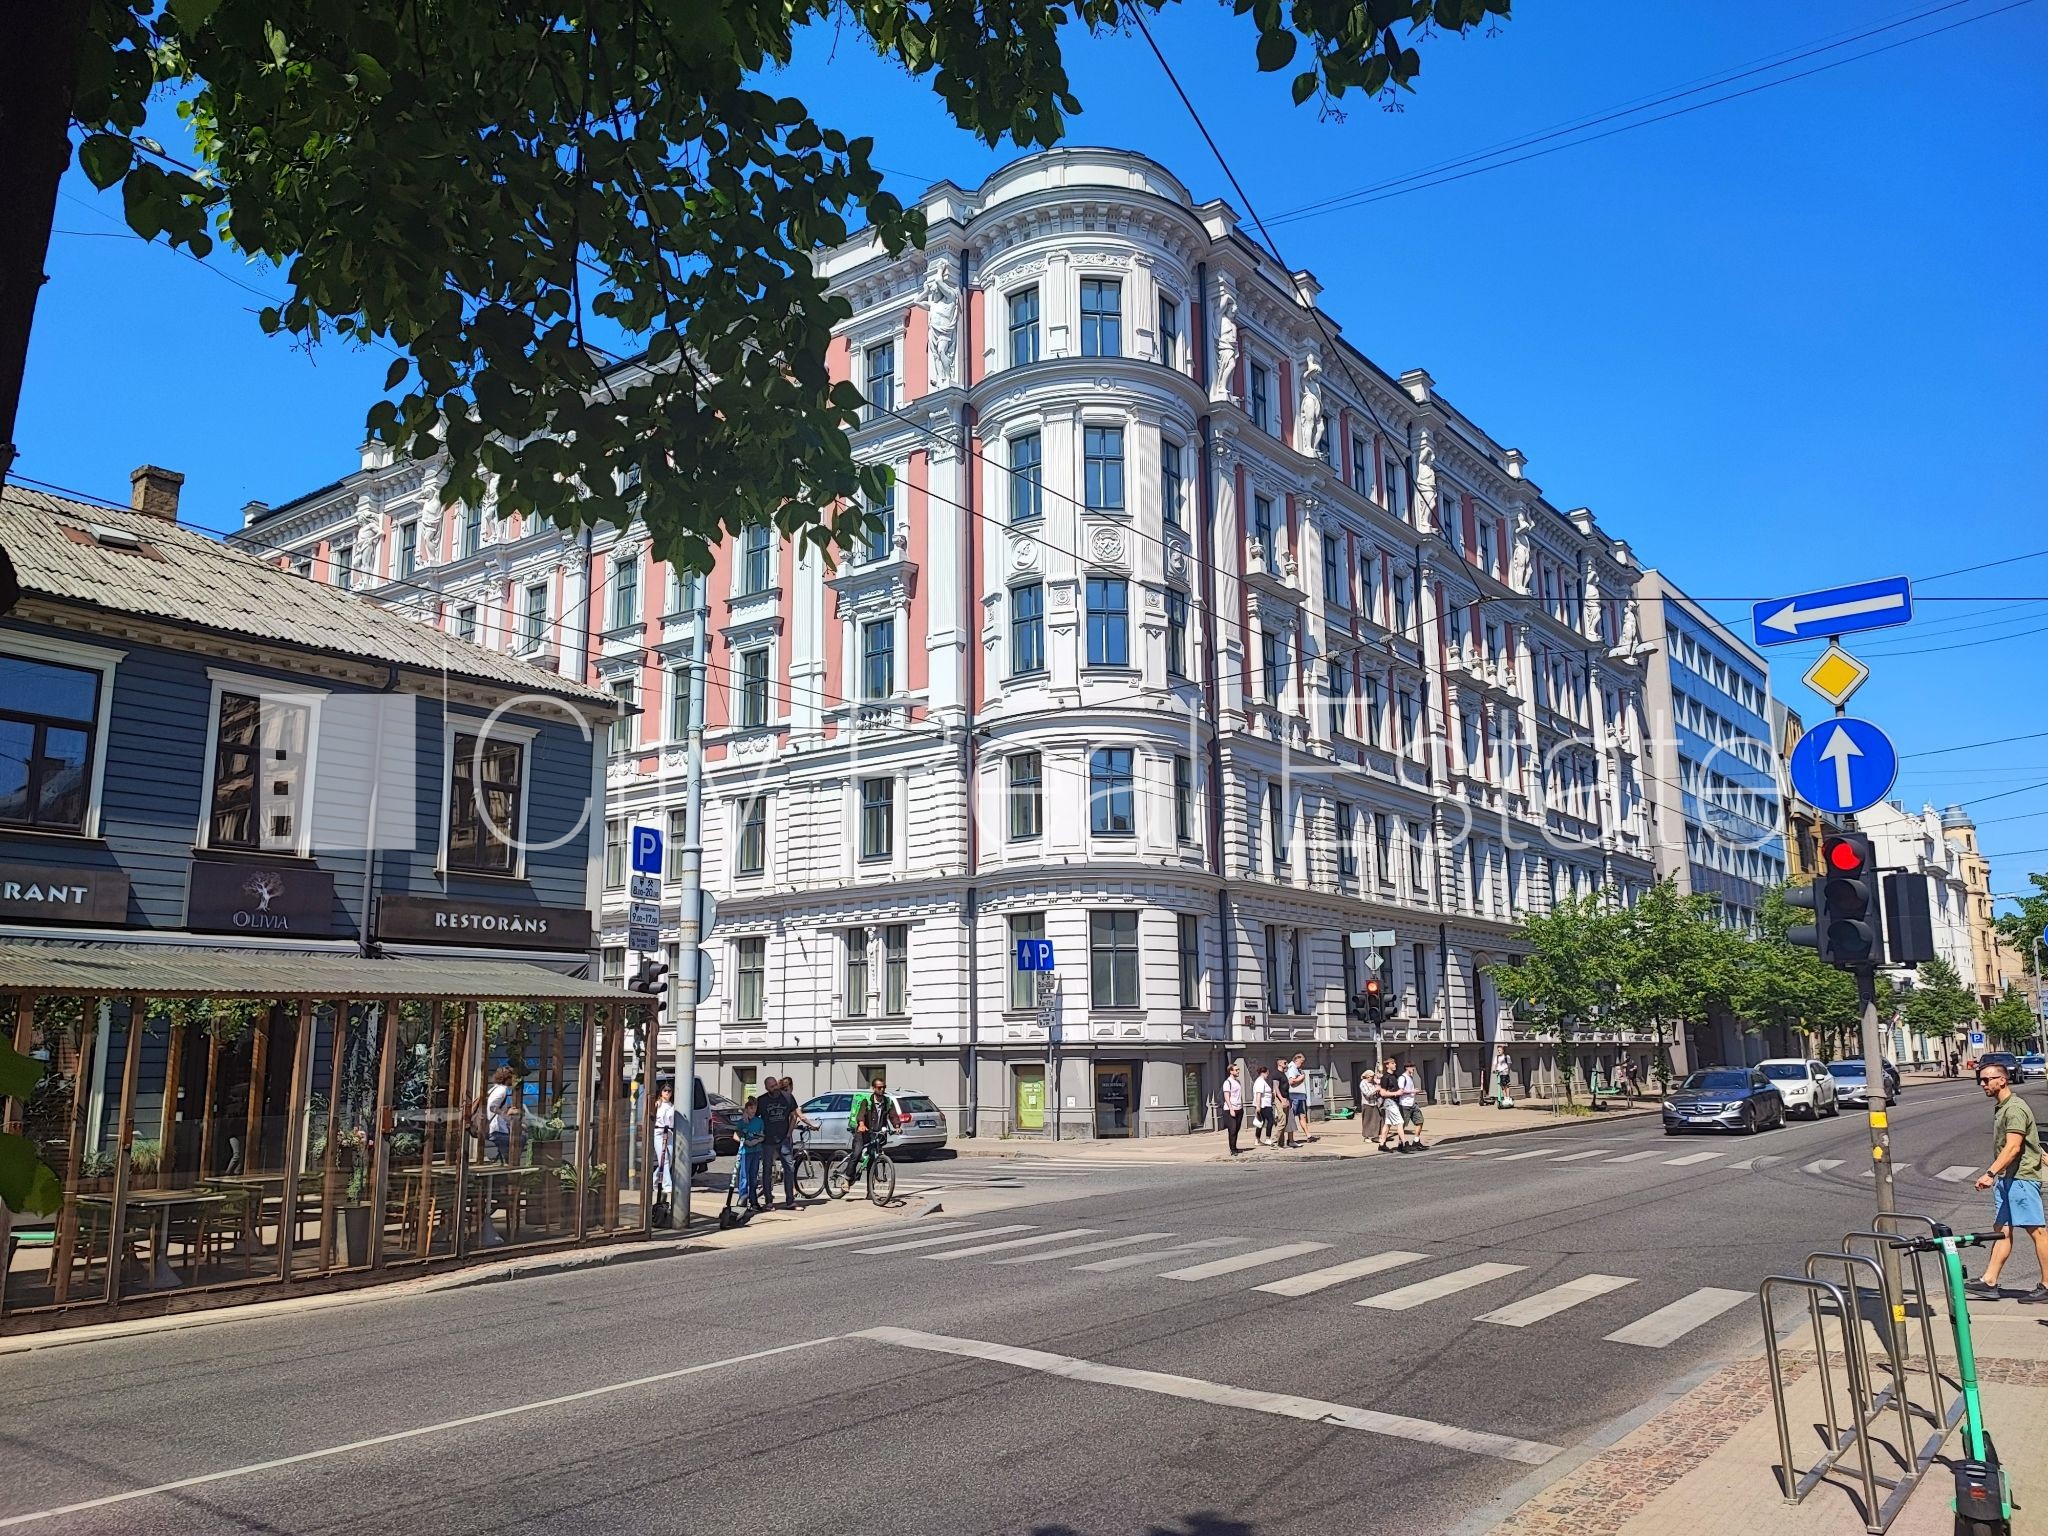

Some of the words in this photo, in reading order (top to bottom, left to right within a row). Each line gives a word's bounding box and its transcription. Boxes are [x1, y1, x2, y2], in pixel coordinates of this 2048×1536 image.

[639, 832, 657, 866] P
[435, 912, 547, 933] RESTORĀNS
[1039, 943, 1050, 968] P
